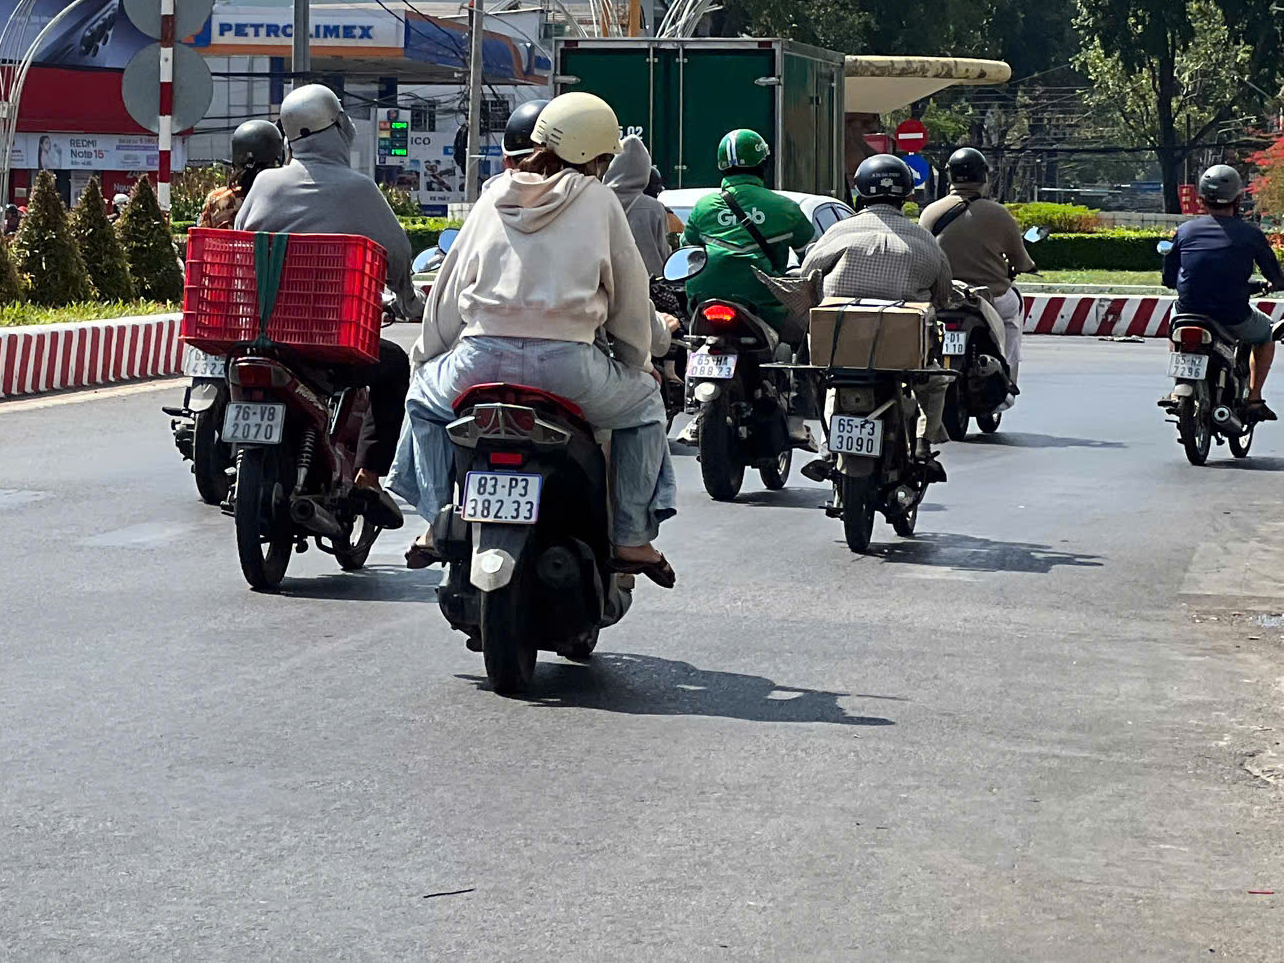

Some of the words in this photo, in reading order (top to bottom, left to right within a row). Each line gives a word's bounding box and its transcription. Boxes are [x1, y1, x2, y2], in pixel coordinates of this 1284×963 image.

[219, 22, 374, 39] PETRIMEX
[69, 139, 98, 148] REDMI
[70, 149, 93, 158] Note
[1172, 366, 1201, 378] 7296
[235, 405, 276, 422] 76-V8
[231, 423, 273, 440] 2070
[836, 435, 874, 453] 3090
[477, 476, 529, 497] 83-P3
[468, 498, 534, 520] 382.33
